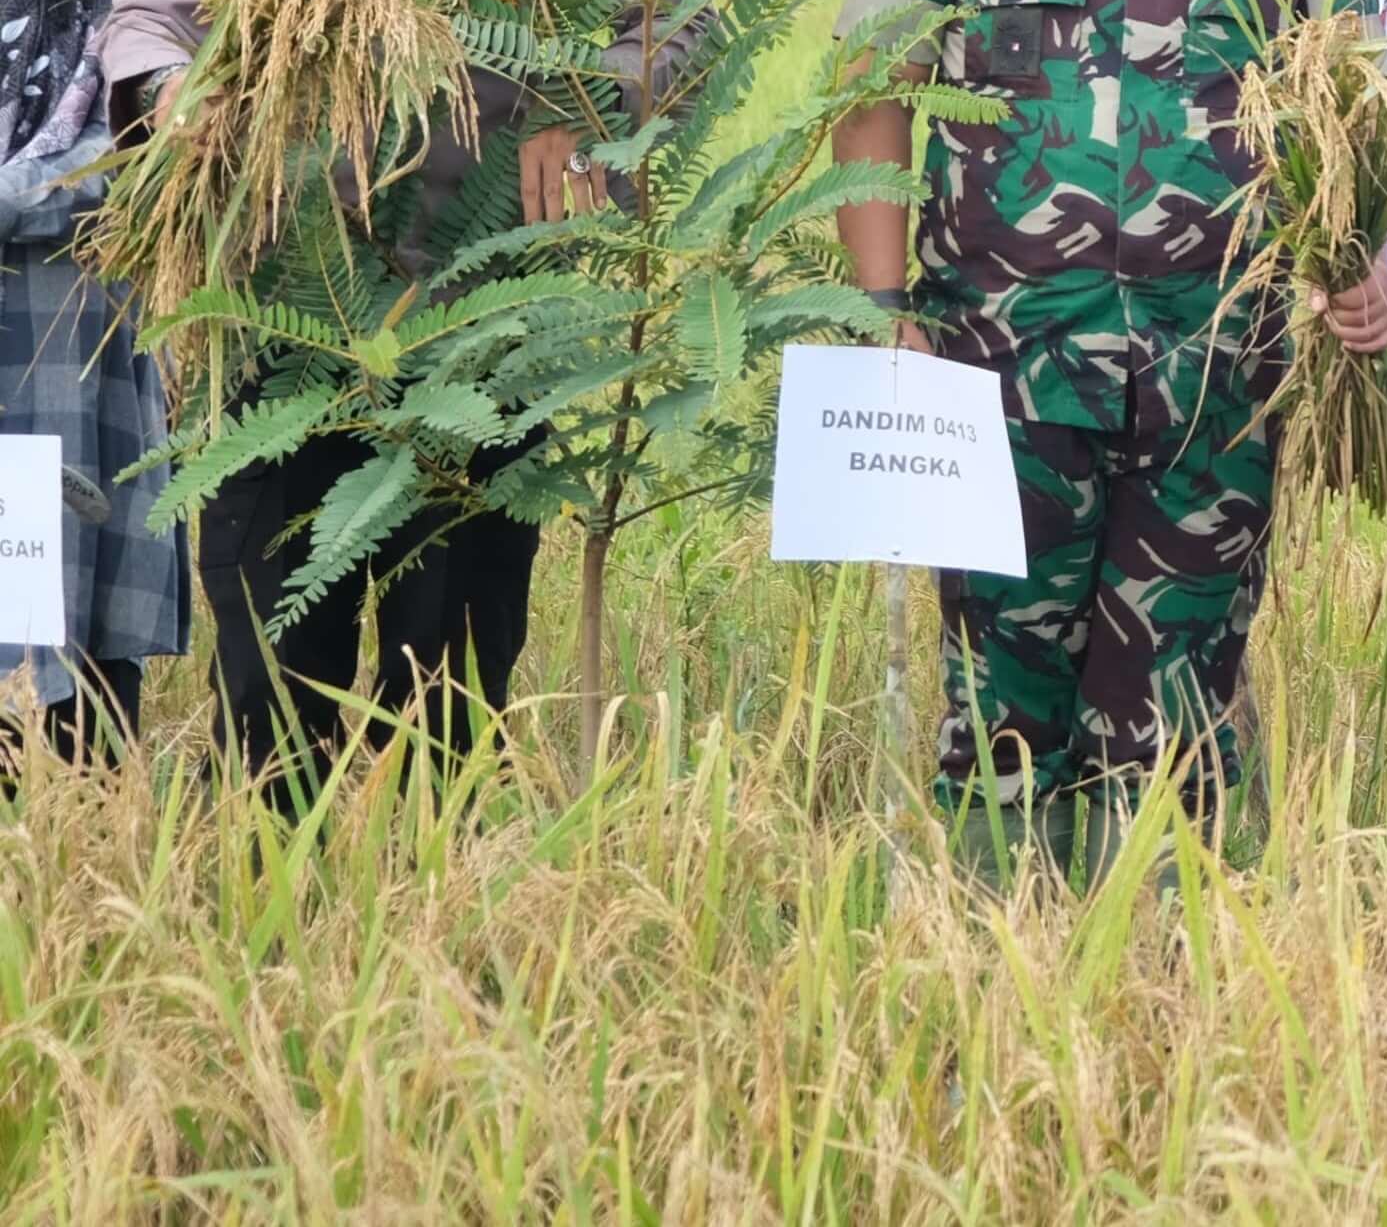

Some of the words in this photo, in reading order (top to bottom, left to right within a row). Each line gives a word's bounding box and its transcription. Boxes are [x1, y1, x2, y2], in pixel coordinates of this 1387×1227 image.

[821, 409, 925, 433] DANDIM
[933, 416, 977, 443] 0413
[849, 451, 961, 479] BANGKA
